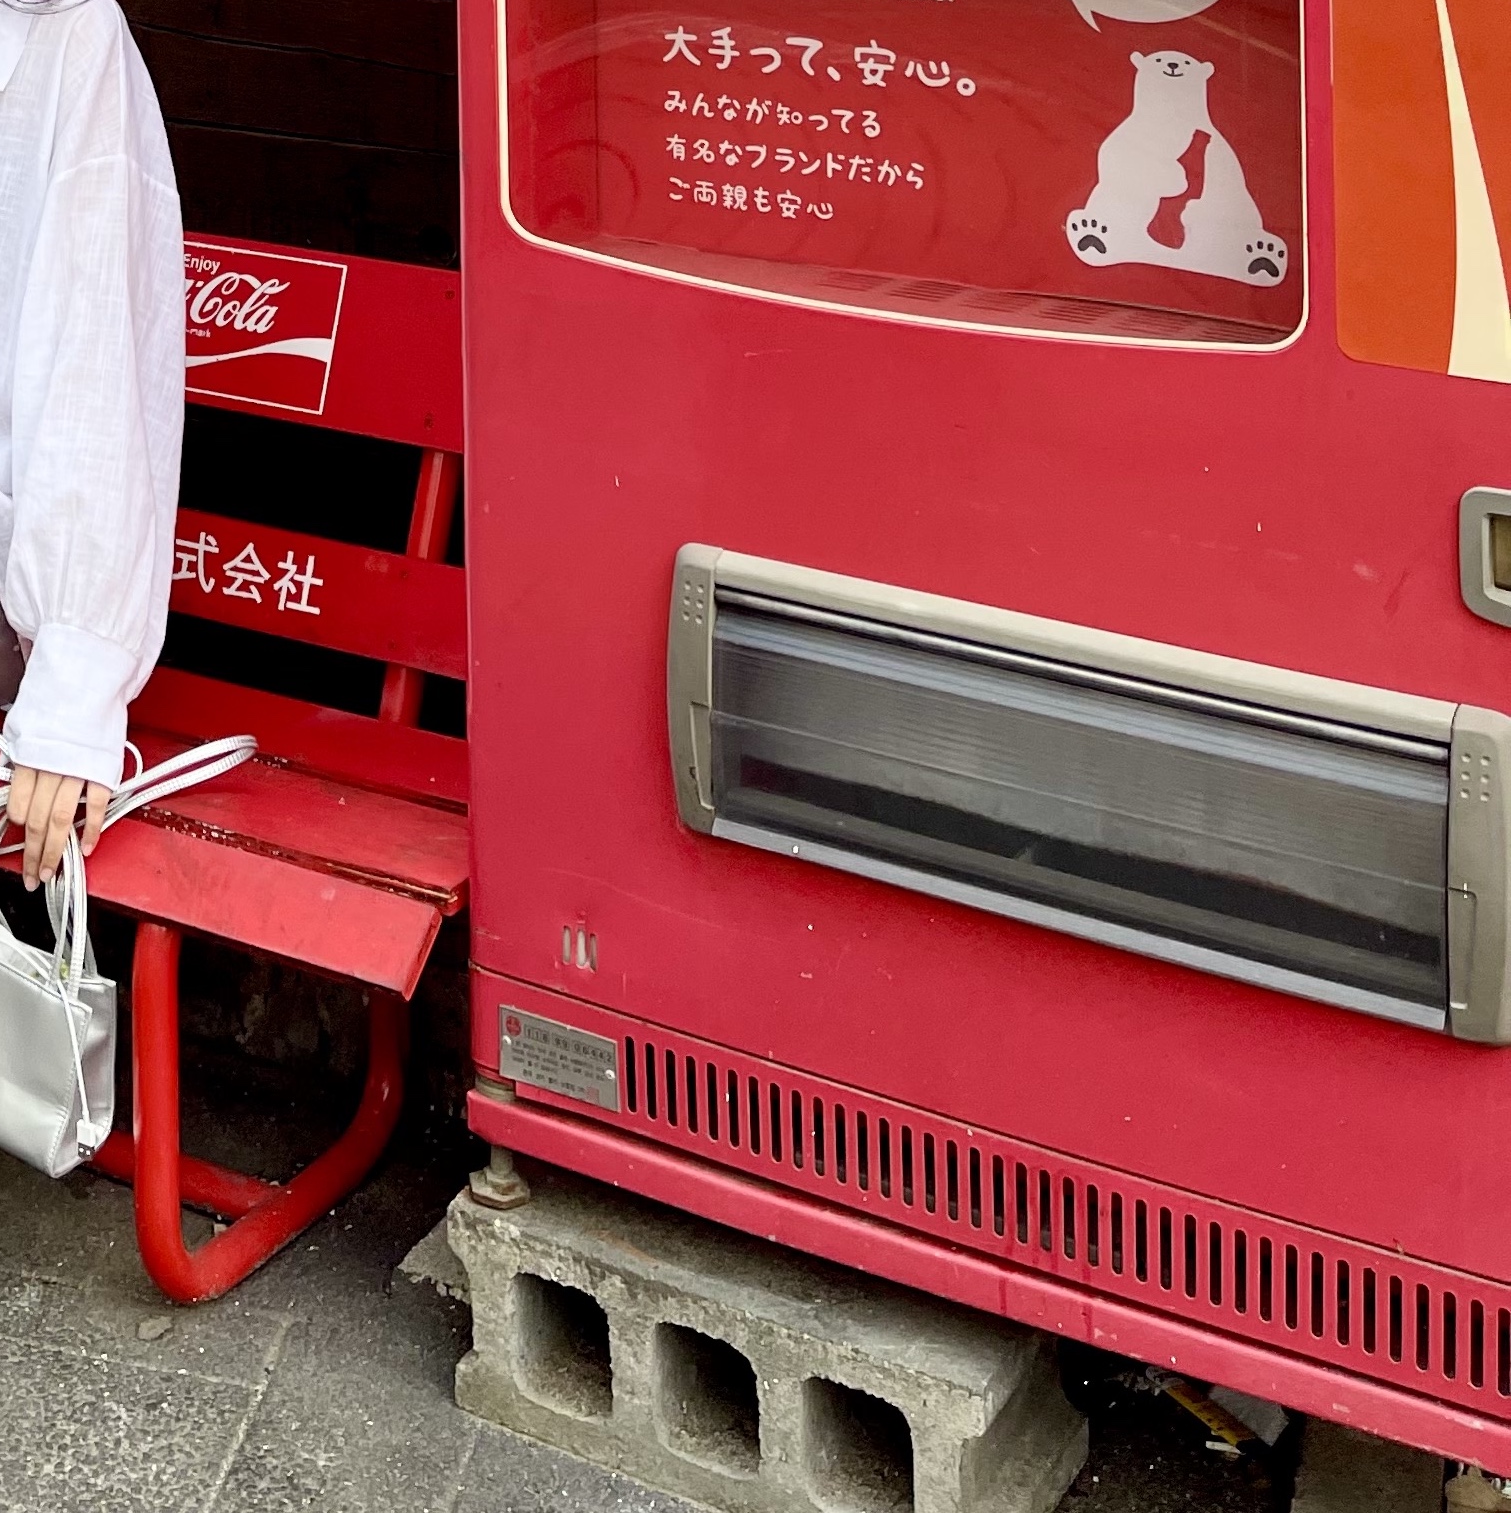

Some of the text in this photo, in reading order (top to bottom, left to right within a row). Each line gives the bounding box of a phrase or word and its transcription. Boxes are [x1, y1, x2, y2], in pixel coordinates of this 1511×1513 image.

[662, 25, 977, 97] 大手って、安心。
[663, 90, 881, 138] みんなが知ってる
[665, 134, 926, 190] 有名なブランドだから
[669, 176, 834, 220] ご両親も安心
[184, 253, 221, 275] Enjoy
[172, 531, 324, 616] 式会社
